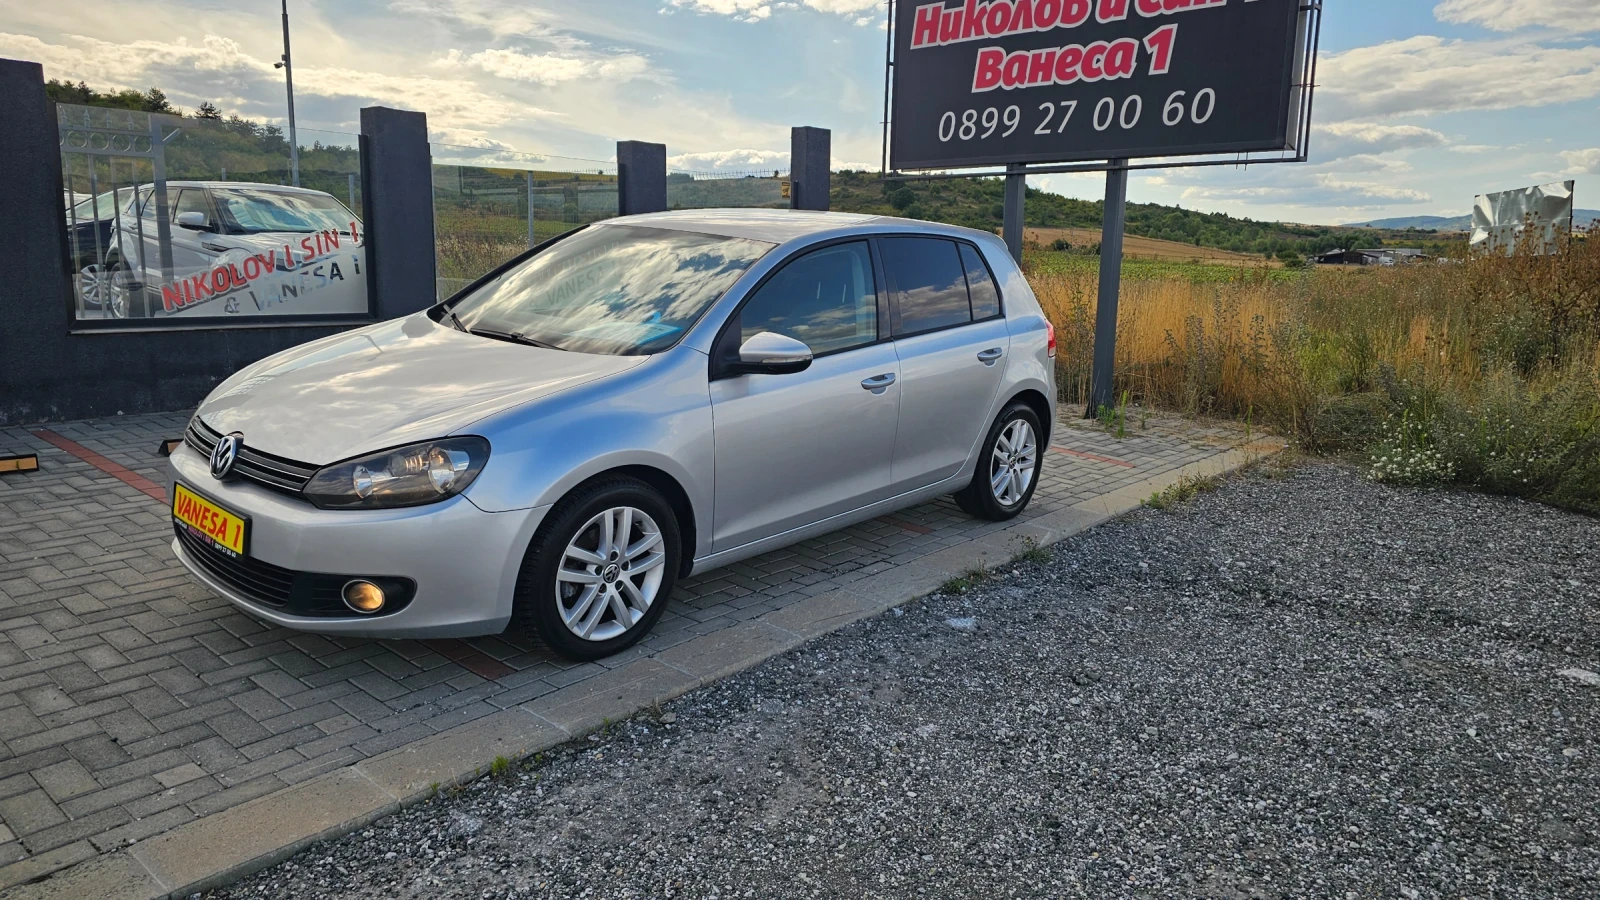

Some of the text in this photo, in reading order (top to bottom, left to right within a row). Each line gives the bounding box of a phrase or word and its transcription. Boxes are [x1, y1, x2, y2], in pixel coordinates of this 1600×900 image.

[911, 0, 1091, 48] Николов
[972, 24, 1178, 92] Ванеса 1
[938, 87, 1216, 142] 0899 27 00 60
[160, 249, 275, 312] NIKOLOV
[300, 228, 340, 262] SIN
[223, 296, 240, 314] &
[248, 261, 345, 312] VANESA
[177, 491, 228, 542] VANESA
[233, 524, 241, 548] 1
